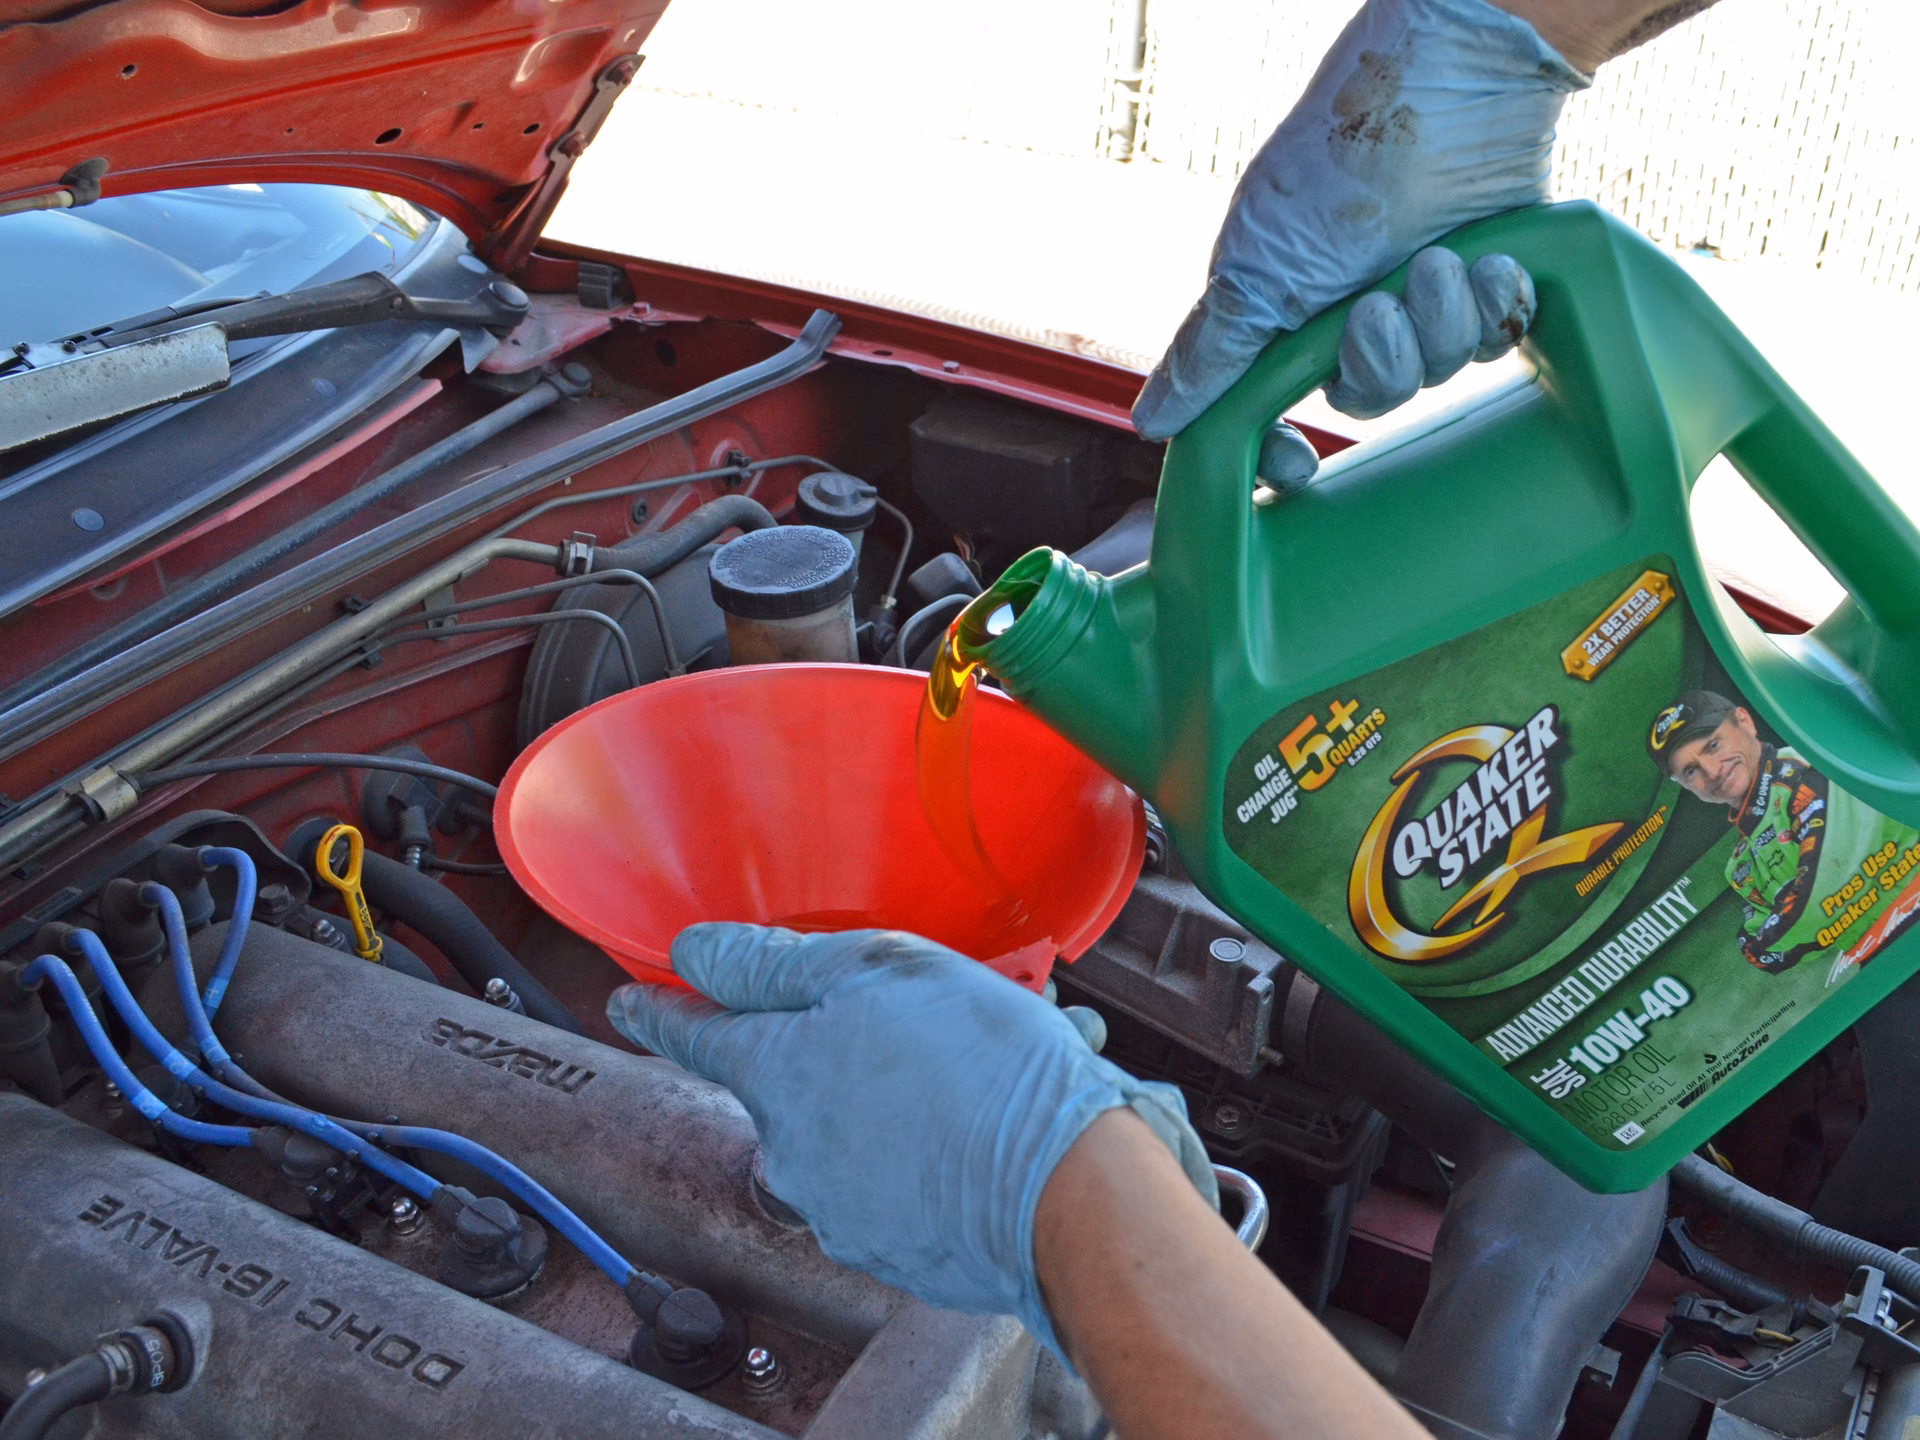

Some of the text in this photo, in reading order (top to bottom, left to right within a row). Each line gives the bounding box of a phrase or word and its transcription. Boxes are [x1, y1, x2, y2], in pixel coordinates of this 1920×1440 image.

[1581, 588, 1651, 655] 2X BETTER
[1587, 639, 1614, 667] WEAR
[1254, 753, 1281, 782] OIL
[1328, 708, 1386, 769] QUARTS
[1347, 731, 1383, 767] 5.28 QTS
[1236, 768, 1293, 824] CHANGE
[1392, 705, 1559, 879] QUAKER
[1438, 758, 1552, 889] STATE
[1575, 857, 1615, 898] DURABLE
[1820, 875, 1865, 918] Pros
[1861, 841, 1898, 878] Use
[1816, 887, 1879, 948] Quaker
[1486, 976, 1595, 1062] ADVANCED
[1529, 975, 1691, 1100] SAE 10W-40
[1567, 1043, 1677, 1124] MOTOR OIL
[1641, 999, 1796, 1127] Recycle Used Oil At Your Nearest Participating
[1650, 1081, 1666, 1095] 5
[1662, 1072, 1678, 1087] L
[1711, 1033, 1770, 1085] AutoZone
[78, 1194, 465, 1392] DOHC 16-VALVE
